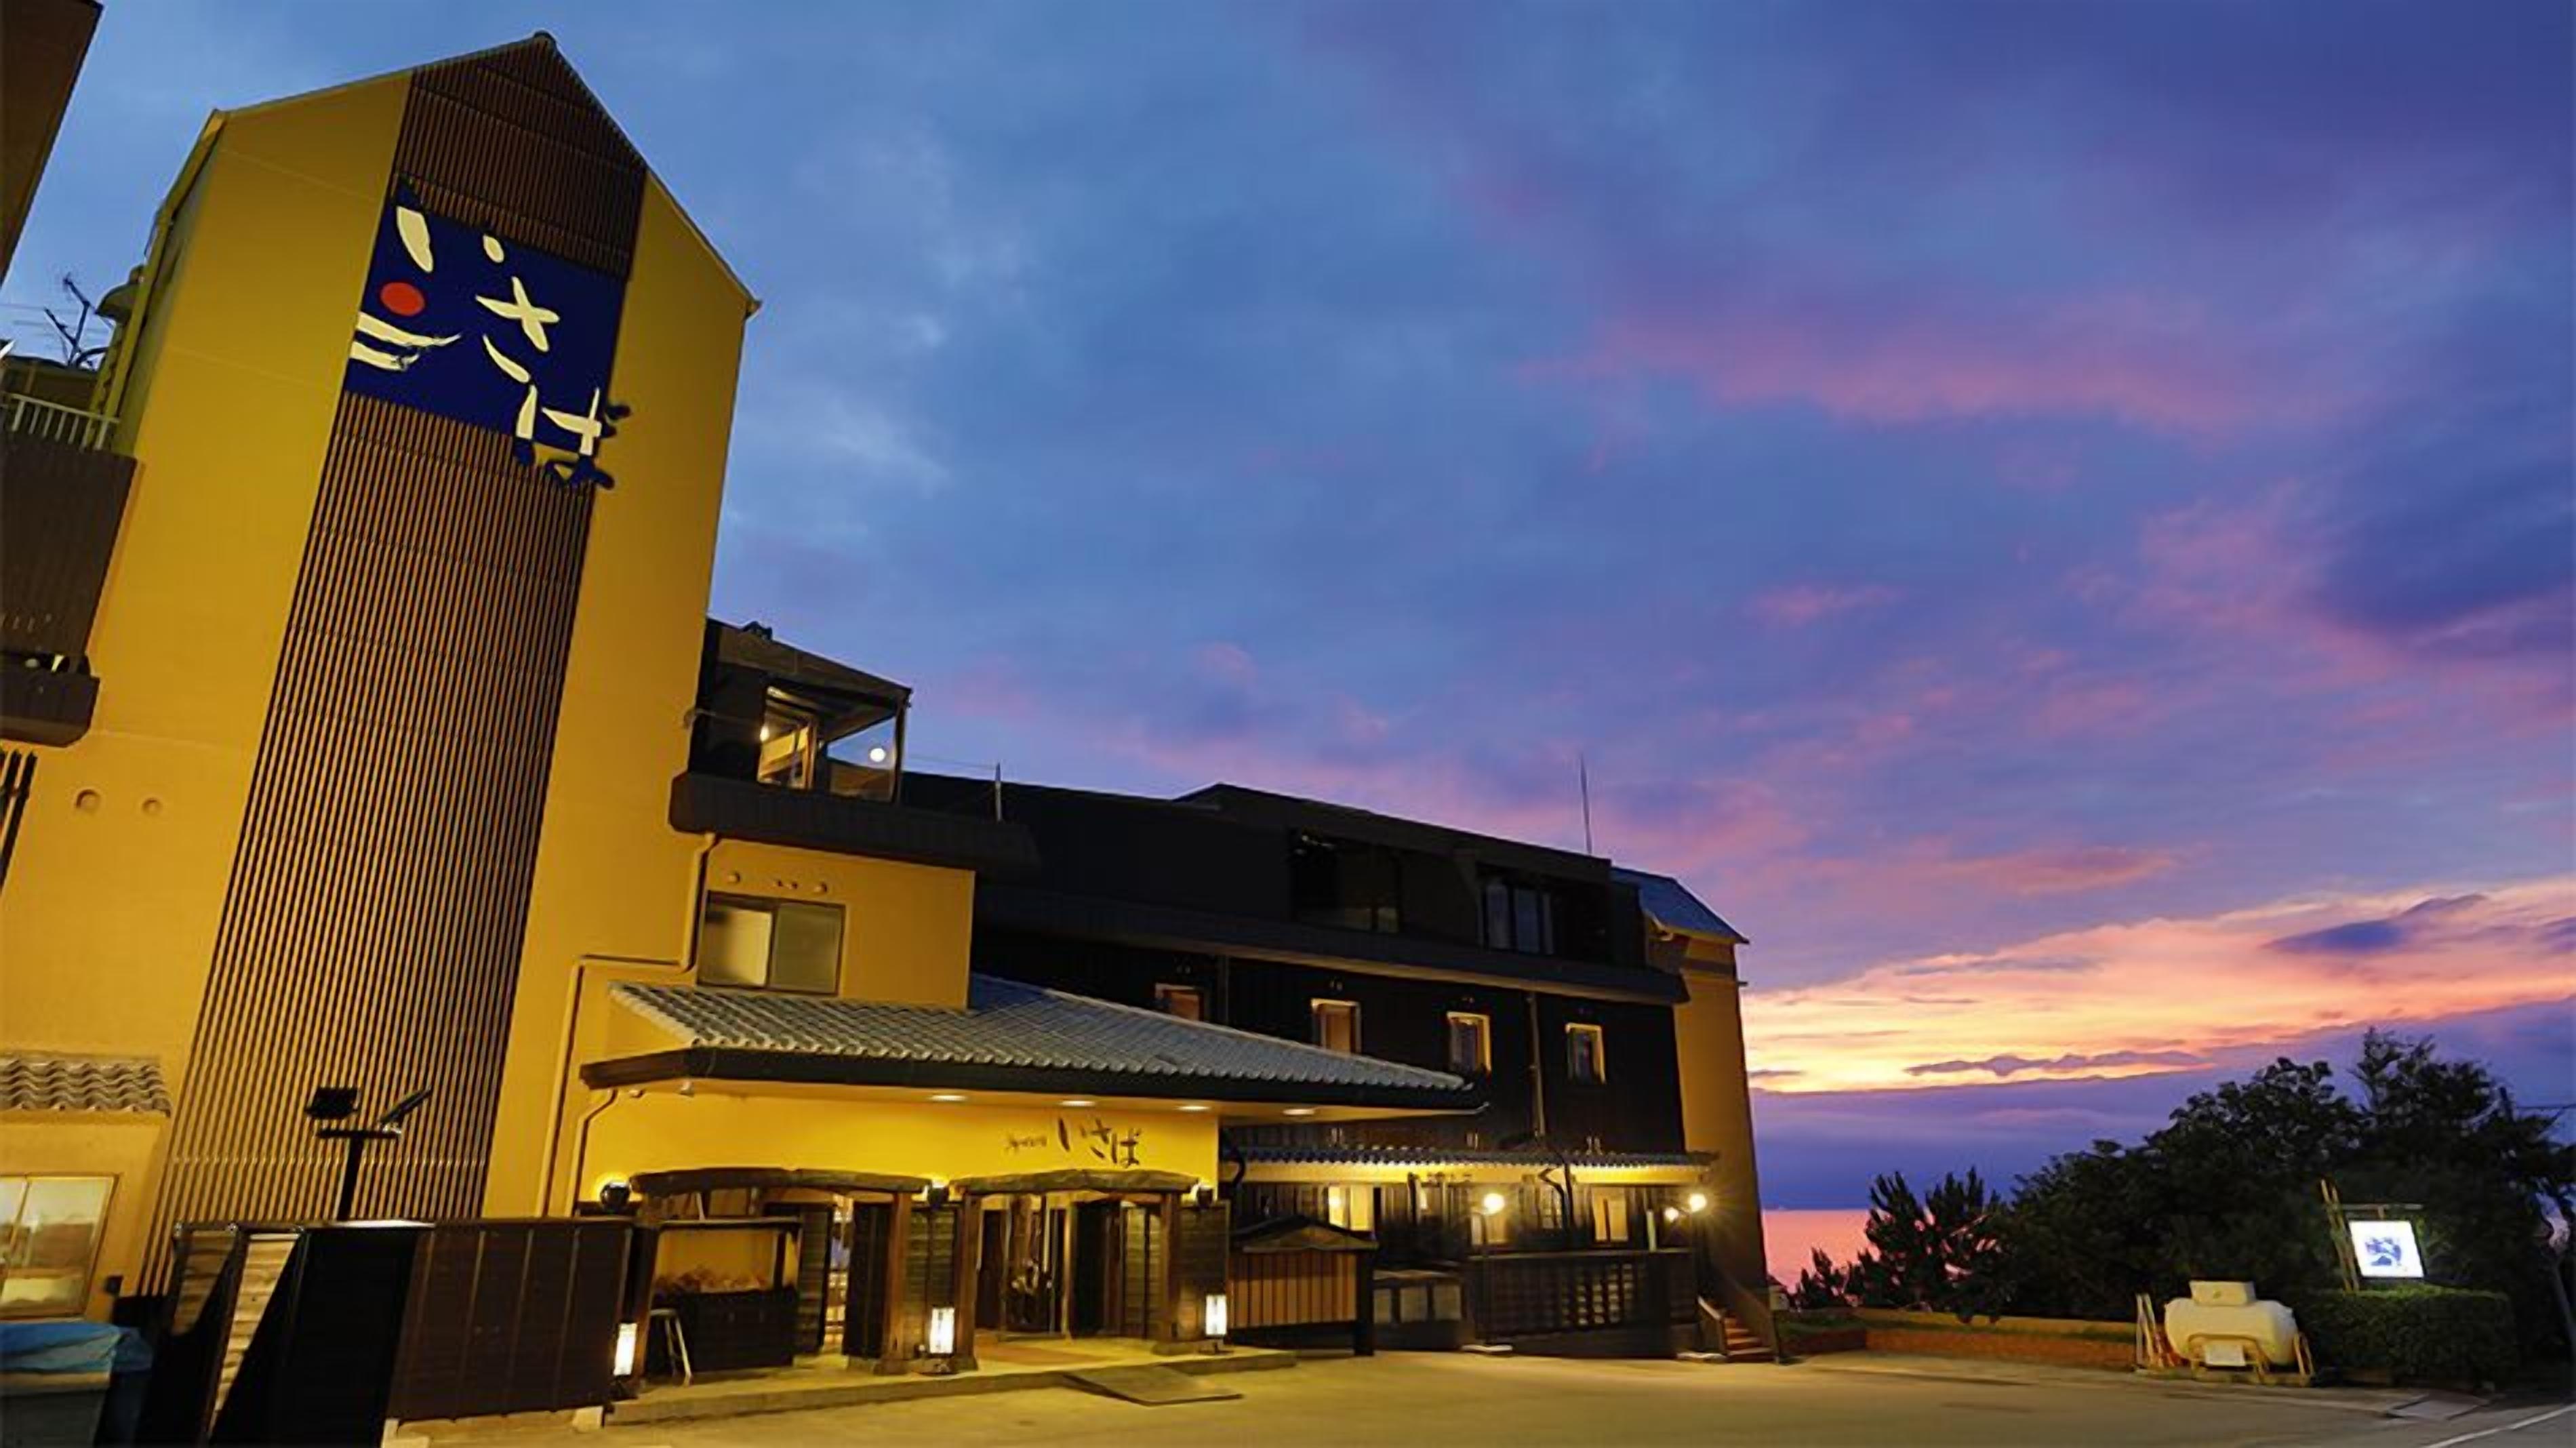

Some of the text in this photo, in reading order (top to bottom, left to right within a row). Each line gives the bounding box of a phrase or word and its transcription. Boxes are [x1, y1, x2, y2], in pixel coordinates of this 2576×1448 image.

[395, 179, 631, 489] いさば
[1057, 1118, 1142, 1168] いさば
